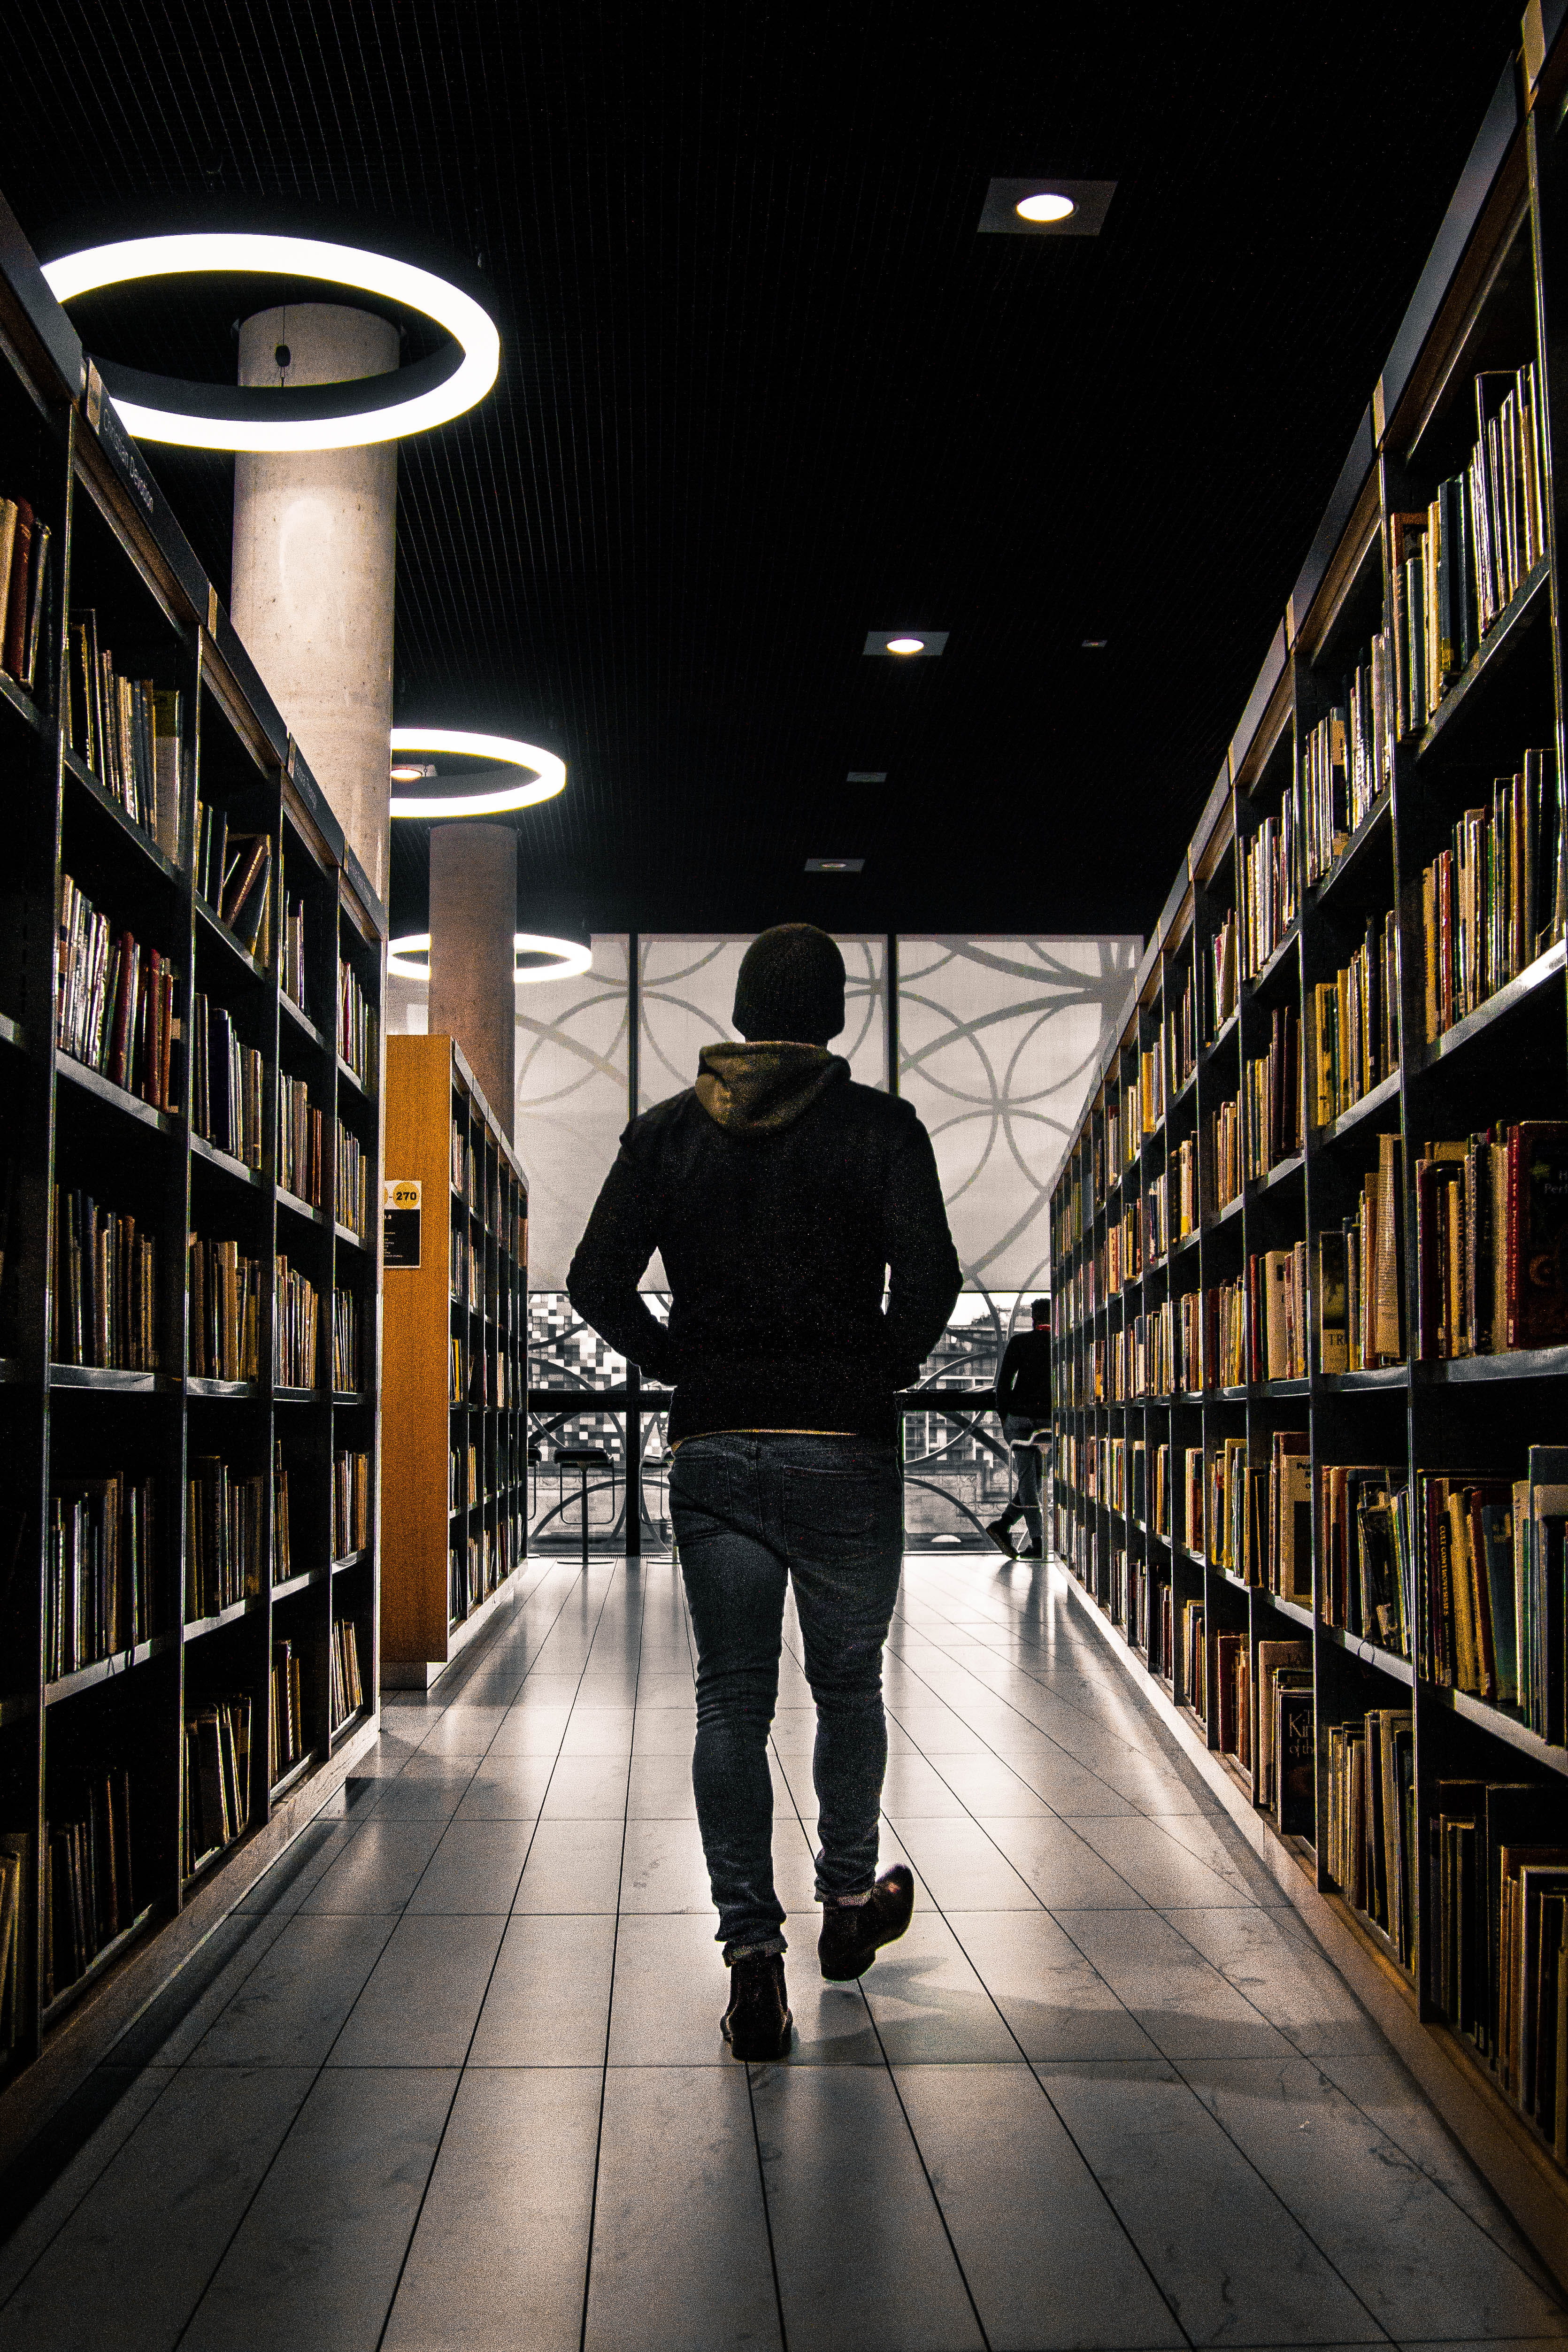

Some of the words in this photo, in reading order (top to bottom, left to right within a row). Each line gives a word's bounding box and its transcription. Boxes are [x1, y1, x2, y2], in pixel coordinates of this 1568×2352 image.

[396, 1191, 416, 1201] 270
[1441, 1546, 1449, 1616] CONTROVERSIES
[1289, 1738, 1300, 1758] of
[1302, 1738, 1314, 1754] th
